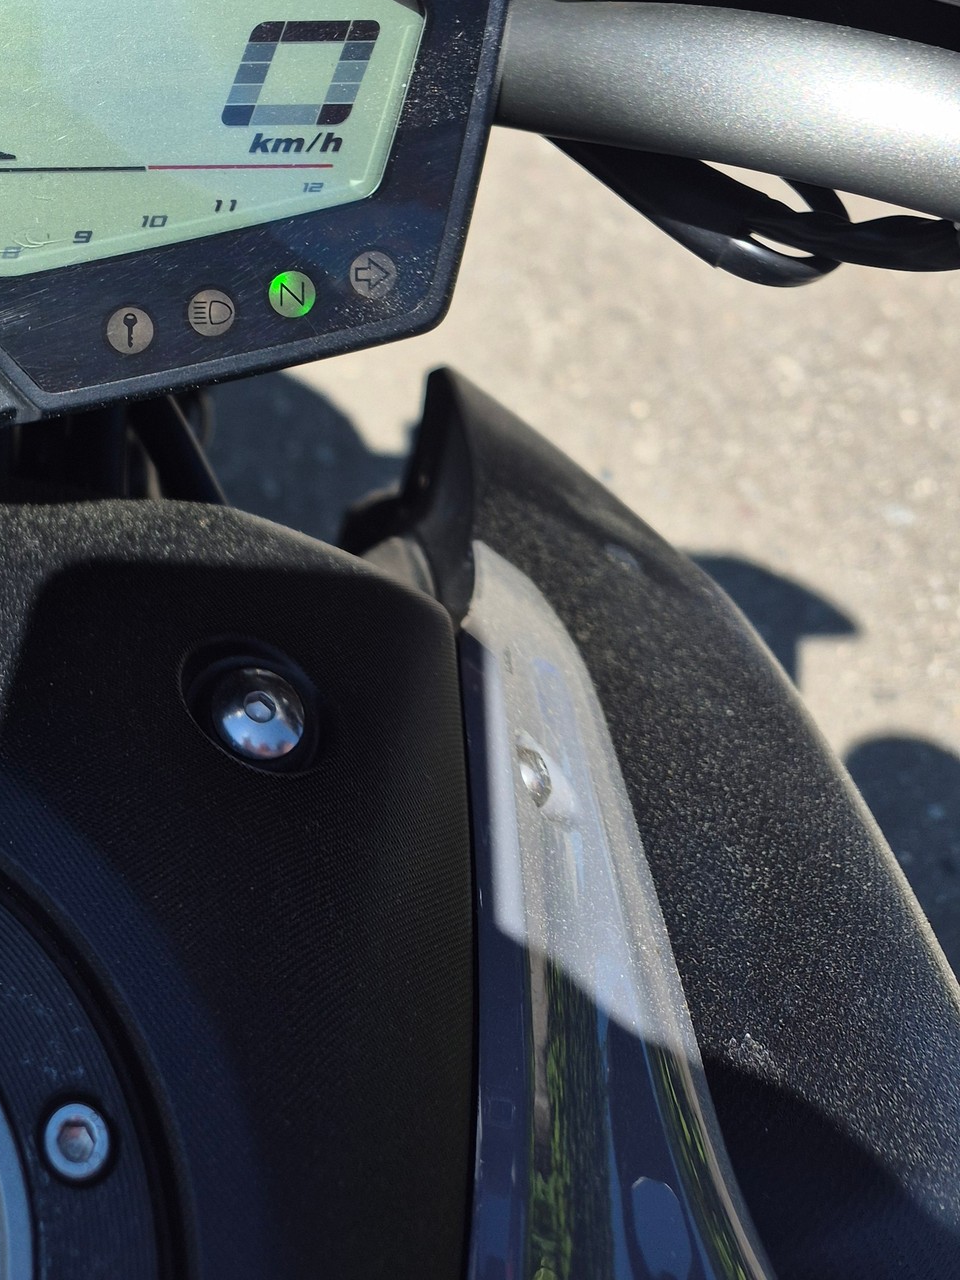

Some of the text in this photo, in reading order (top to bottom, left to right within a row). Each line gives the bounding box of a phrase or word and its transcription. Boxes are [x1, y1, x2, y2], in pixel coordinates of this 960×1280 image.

[221, 19, 381, 126] 0
[248, 132, 343, 153] km/h
[302, 182, 325, 193] 12
[214, 199, 238, 212] 11
[141, 215, 168, 228] 10
[72, 230, 93, 244] 9
[1, 246, 23, 260] 8
[280, 281, 305, 308] N
